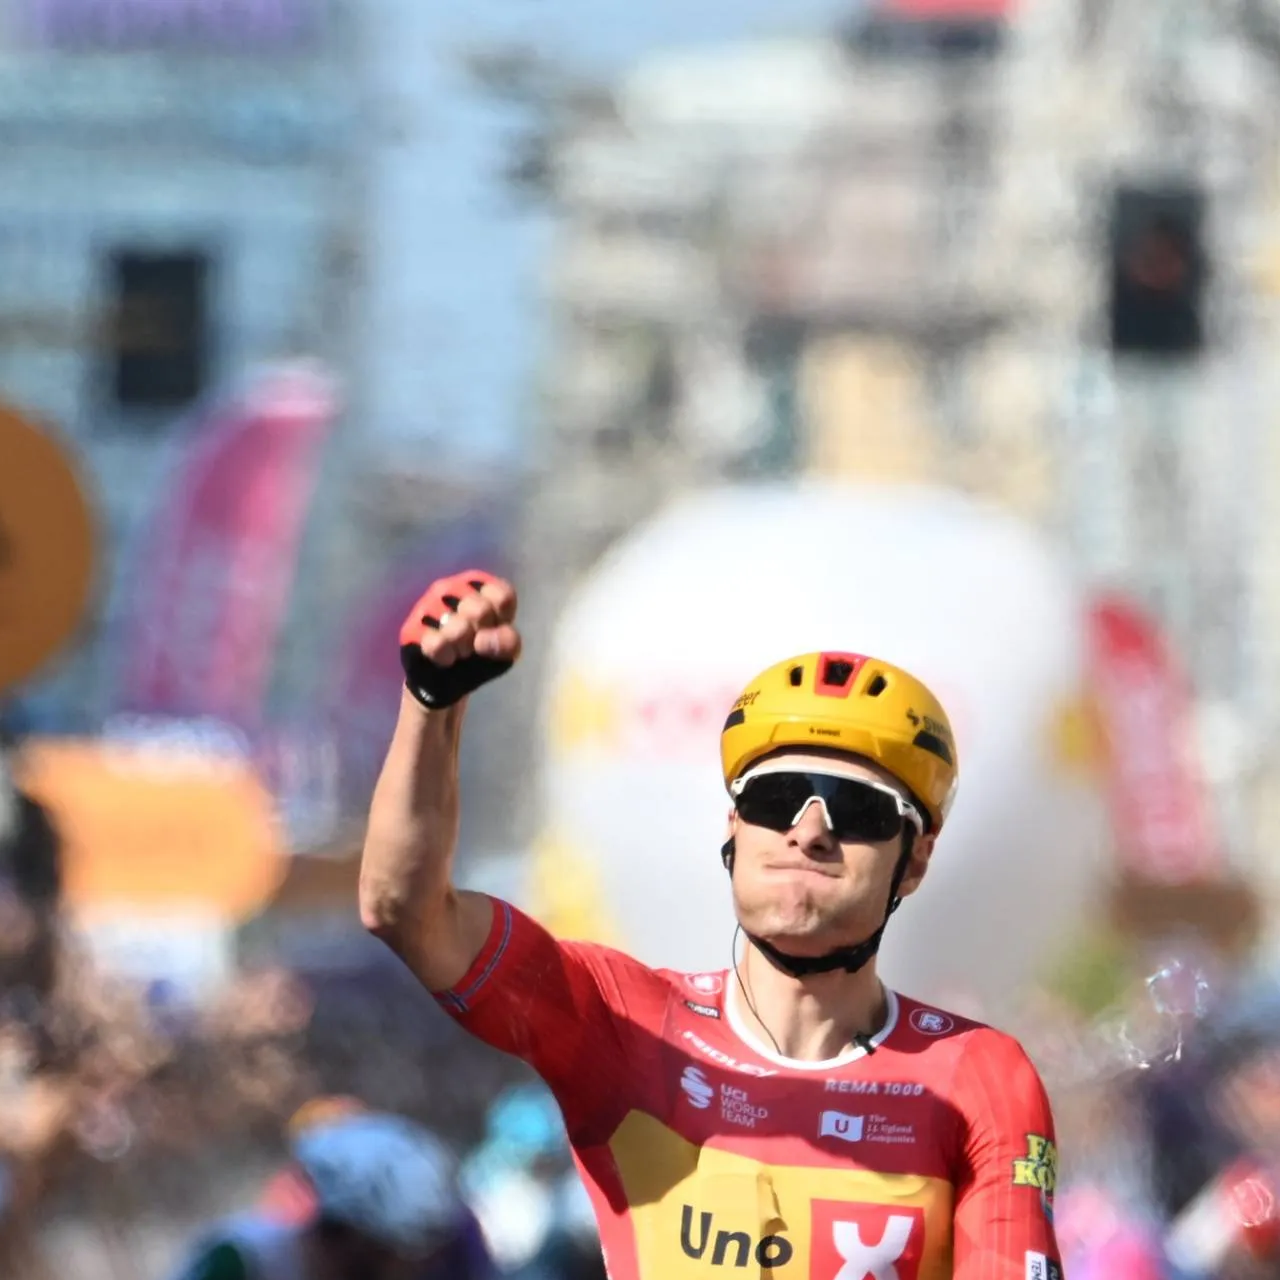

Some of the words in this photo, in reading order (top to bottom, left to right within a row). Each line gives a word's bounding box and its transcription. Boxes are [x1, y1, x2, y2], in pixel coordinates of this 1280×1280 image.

[721, 1083, 748, 1102] UCI
[824, 1079, 879, 1095] REMA
[883, 1082, 925, 1096] 1000
[721, 1096, 768, 1119] WORLD
[721, 1108, 755, 1128] TEAM
[835, 1119, 849, 1134] U
[681, 1205, 793, 1268] Uno
